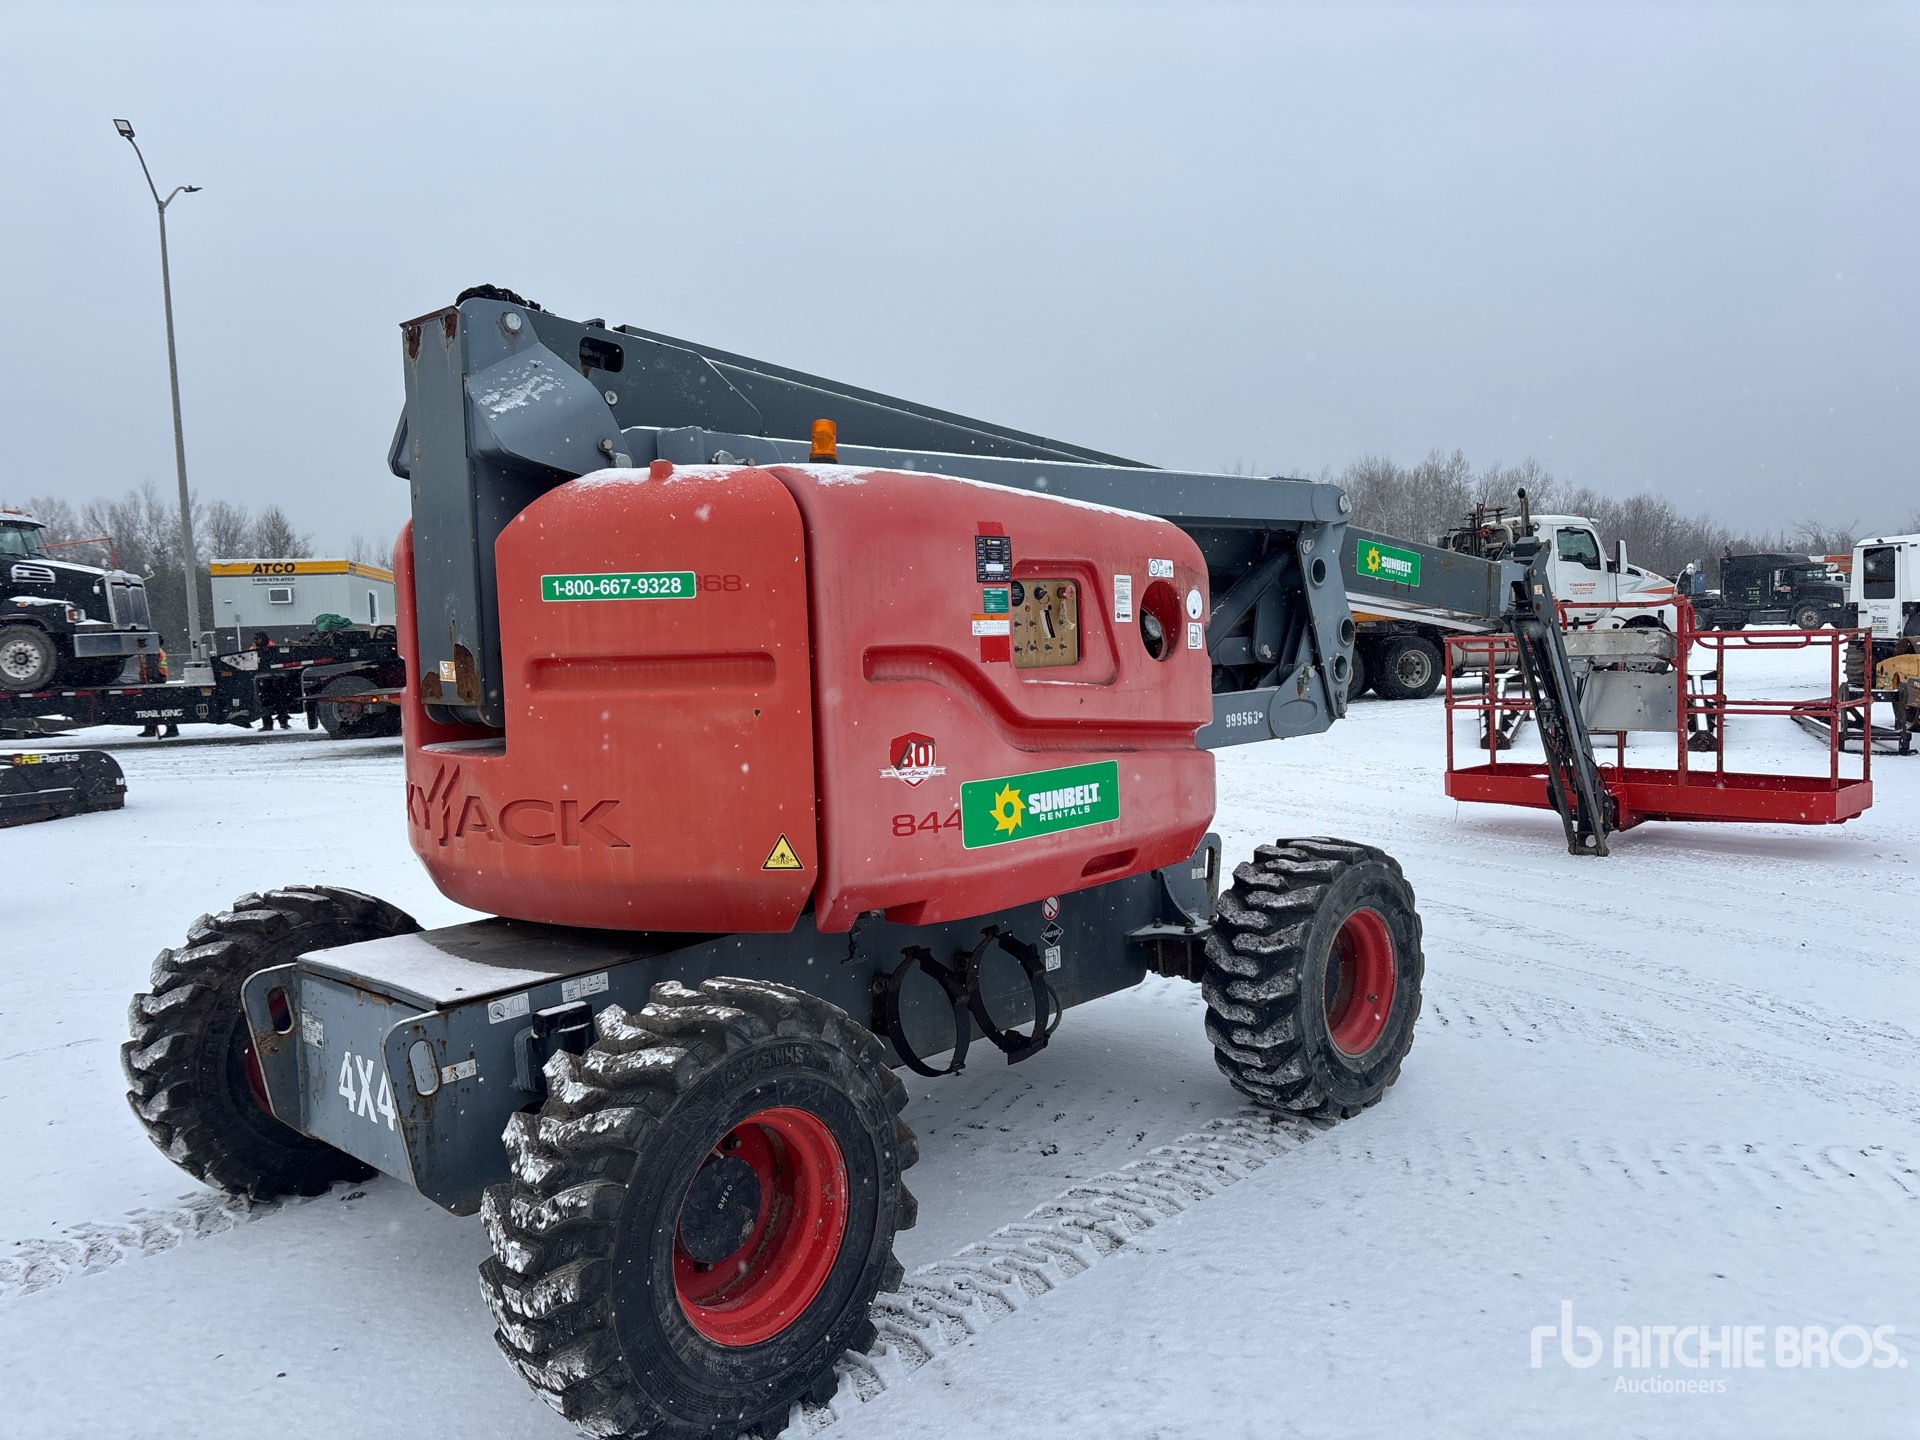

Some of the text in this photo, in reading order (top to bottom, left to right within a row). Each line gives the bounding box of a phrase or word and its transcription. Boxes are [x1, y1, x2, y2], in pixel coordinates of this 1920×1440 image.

[252, 562, 295, 574] ATCO
[1381, 556, 1412, 573] SUNBELT
[1385, 569, 1407, 577] RENTALS
[552, 577, 682, 596] 1-800-667-9328
[696, 574, 742, 591] 68
[135, 710, 160, 719] TRAIL
[898, 769, 929, 777] SKYJACK
[1028, 782, 1100, 815] SUNBELT
[1039, 805, 1091, 822] RENTALS
[338, 1050, 396, 1132] 4X4
